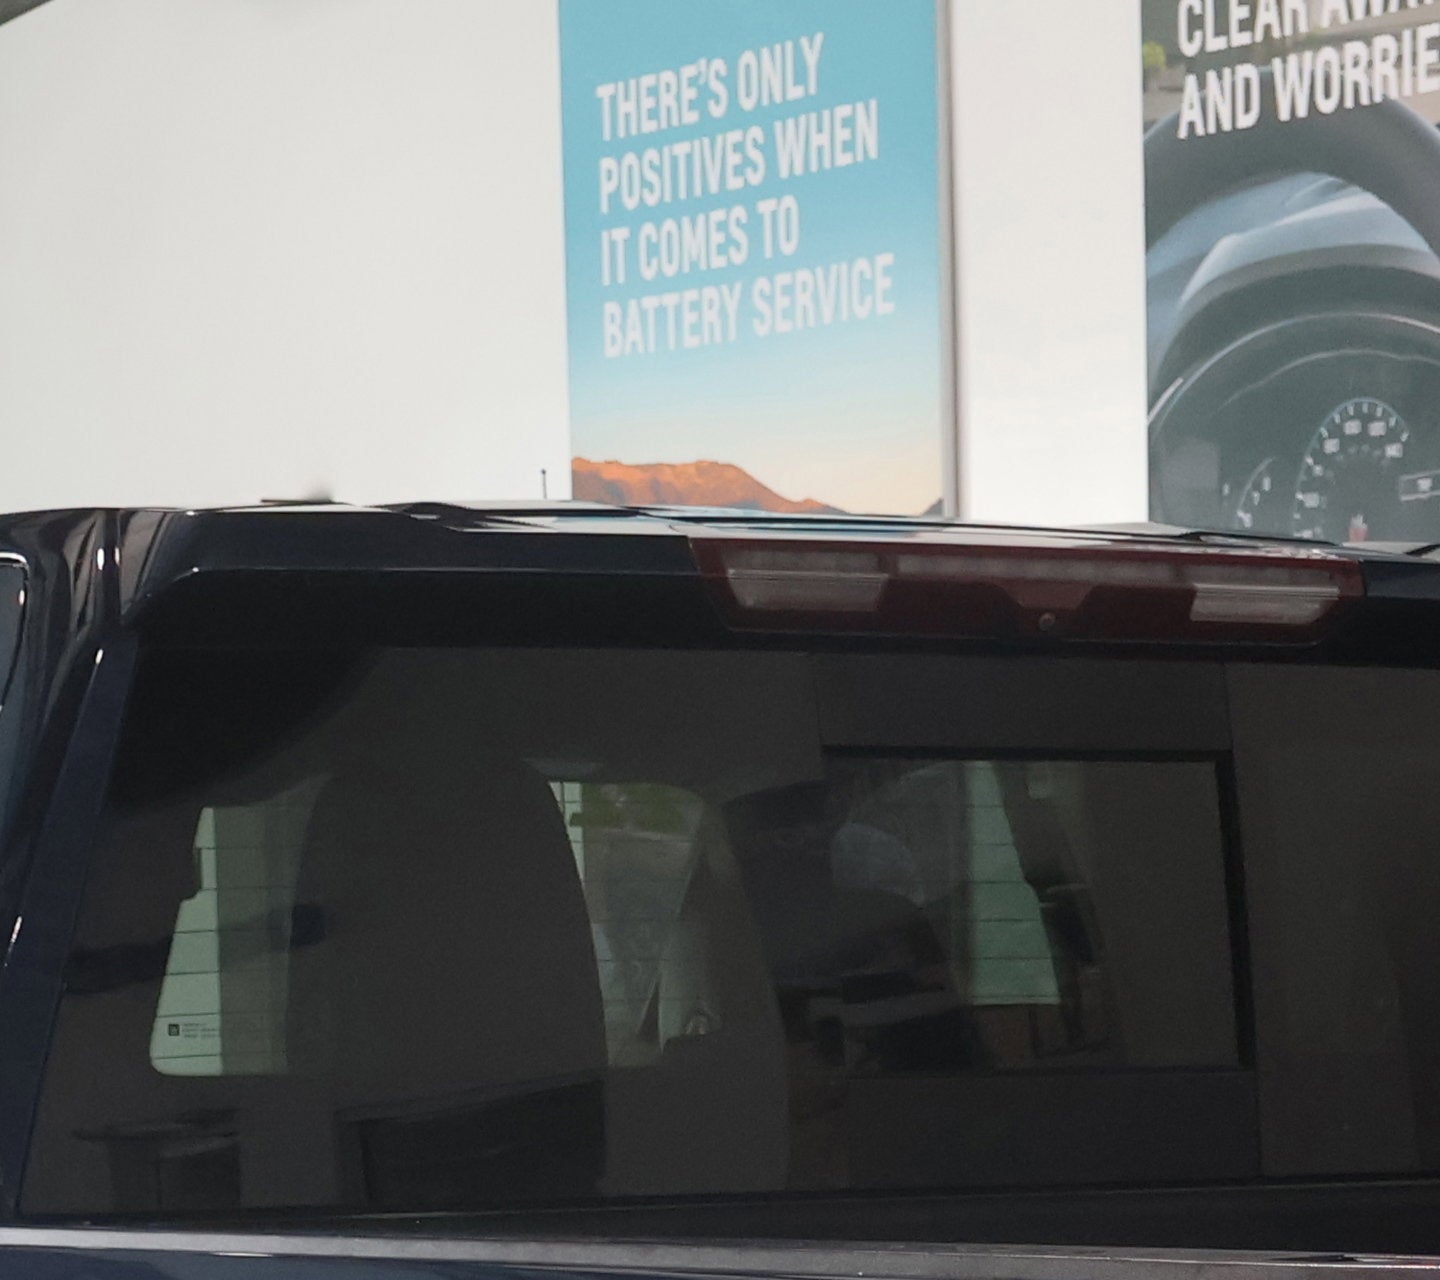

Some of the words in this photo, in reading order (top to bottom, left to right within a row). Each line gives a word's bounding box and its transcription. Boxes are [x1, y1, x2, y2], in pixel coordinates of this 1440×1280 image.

[595, 56, 729, 142] THERE'S
[737, 32, 825, 112] ONLY
[1177, 63, 1261, 140] AND
[599, 125, 767, 216] POSITIVES
[773, 98, 879, 180] WHEN
[600, 226, 631, 287] IT
[638, 204, 750, 282] COMES
[756, 194, 800, 260] TO
[603, 281, 743, 359] BATTERY
[752, 252, 896, 338] SERVICE
